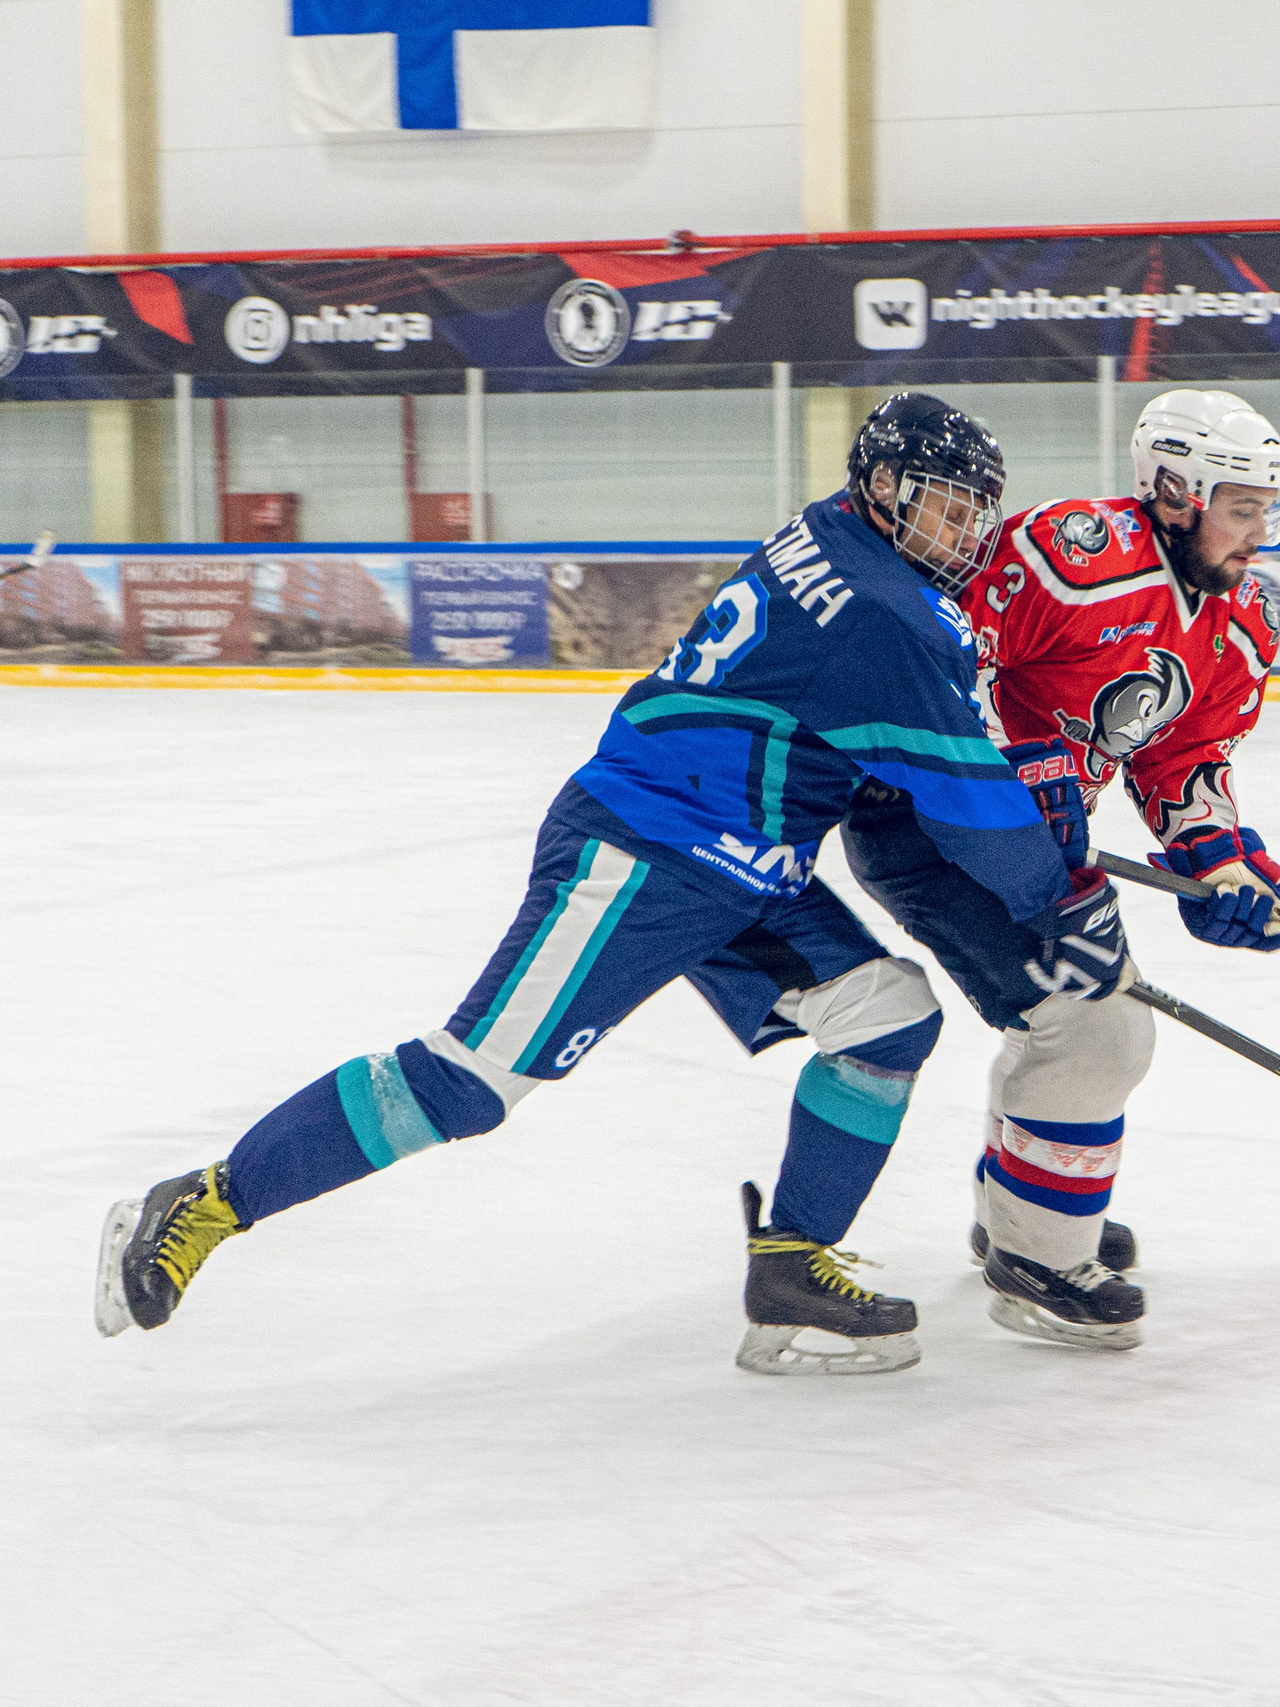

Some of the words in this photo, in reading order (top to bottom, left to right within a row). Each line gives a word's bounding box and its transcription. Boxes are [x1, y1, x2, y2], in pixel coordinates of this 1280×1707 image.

[292, 302, 433, 351] nhliga
[1153, 441, 1189, 456] BAUER
[1018, 755, 1078, 788] BAU
[692, 845, 767, 891] ЦЕНТРАЛЬНОЕ
